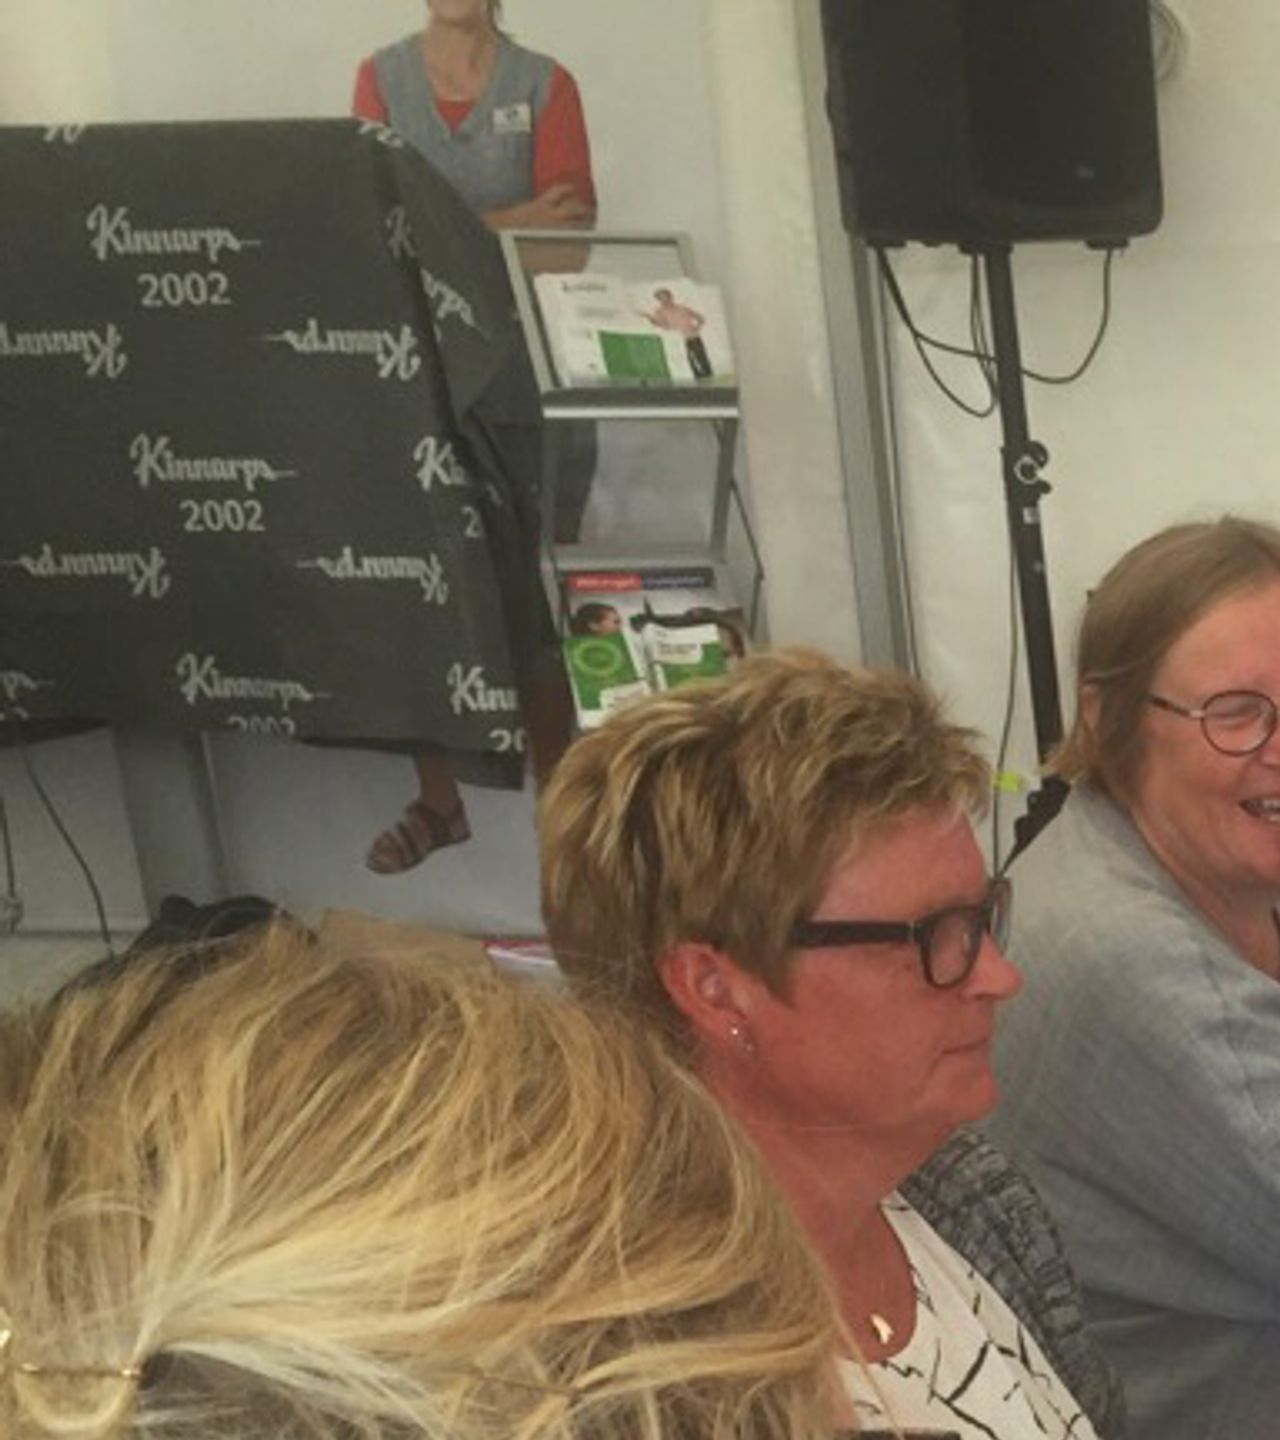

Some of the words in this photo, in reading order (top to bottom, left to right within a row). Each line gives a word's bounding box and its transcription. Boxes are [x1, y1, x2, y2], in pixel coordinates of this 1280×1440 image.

[86, 203, 261, 262] Kinnarps
[137, 271, 232, 307] 2002
[129, 433, 297, 491] Kinnarps
[179, 499, 265, 532] 2002
[176, 652, 332, 711] Kinnarps
